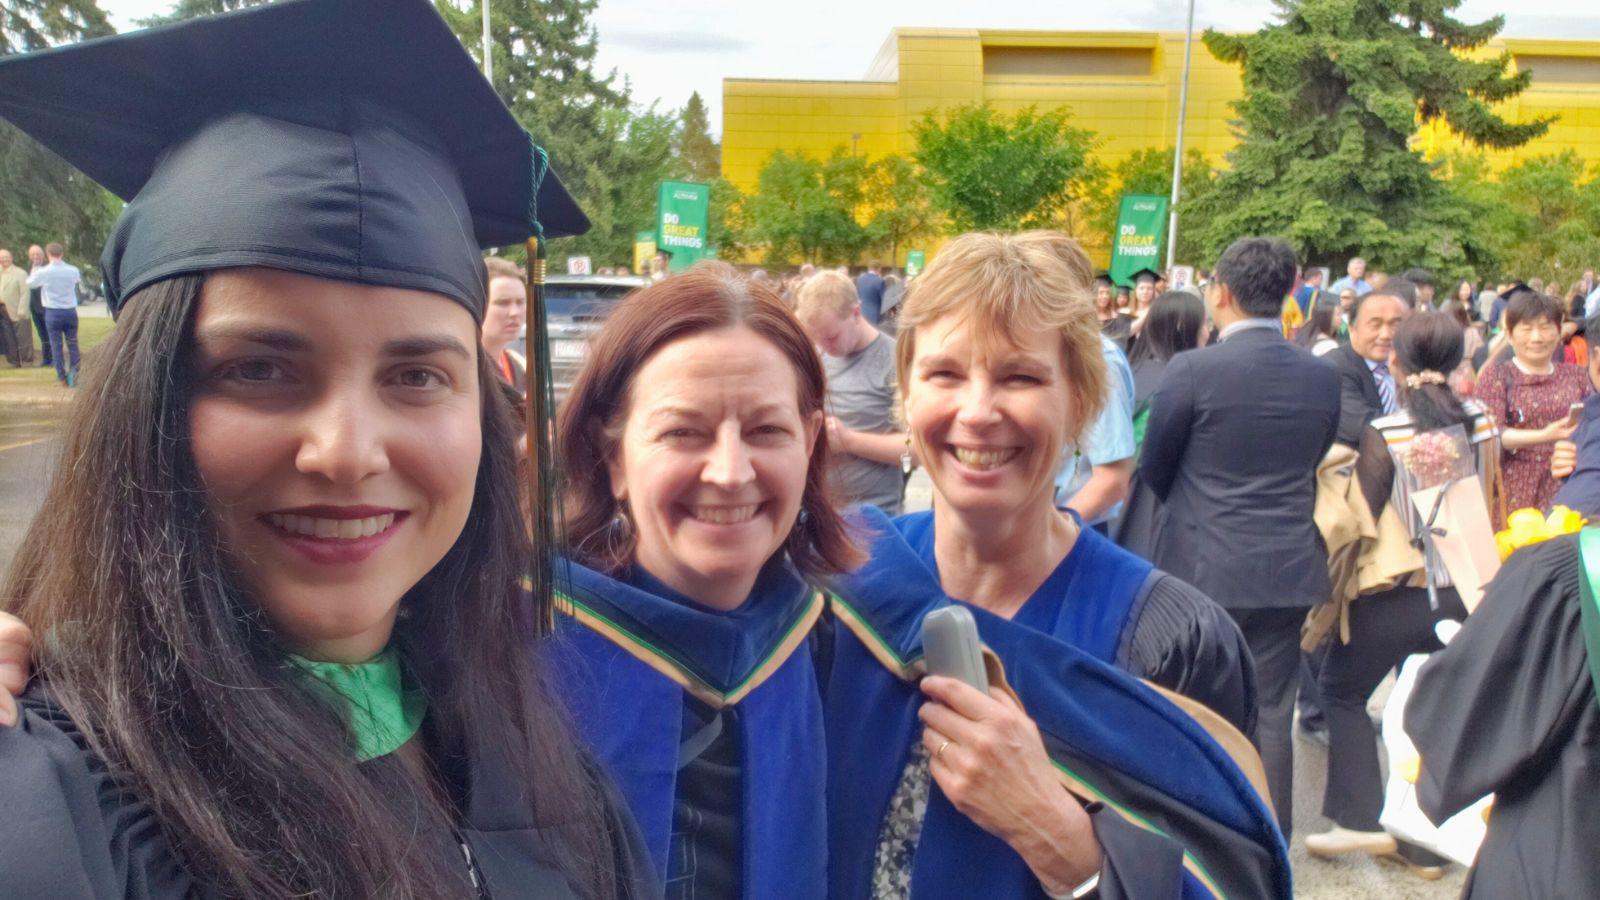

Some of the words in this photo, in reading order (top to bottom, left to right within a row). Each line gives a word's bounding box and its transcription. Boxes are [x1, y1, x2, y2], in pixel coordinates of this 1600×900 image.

[664, 213, 679, 224] DO
[664, 224, 699, 237] GREAT
[1121, 225, 1136, 235] DO
[664, 235, 702, 248] THINGS
[1120, 235, 1155, 246] GREAT
[1119, 245, 1157, 256] THINGS
